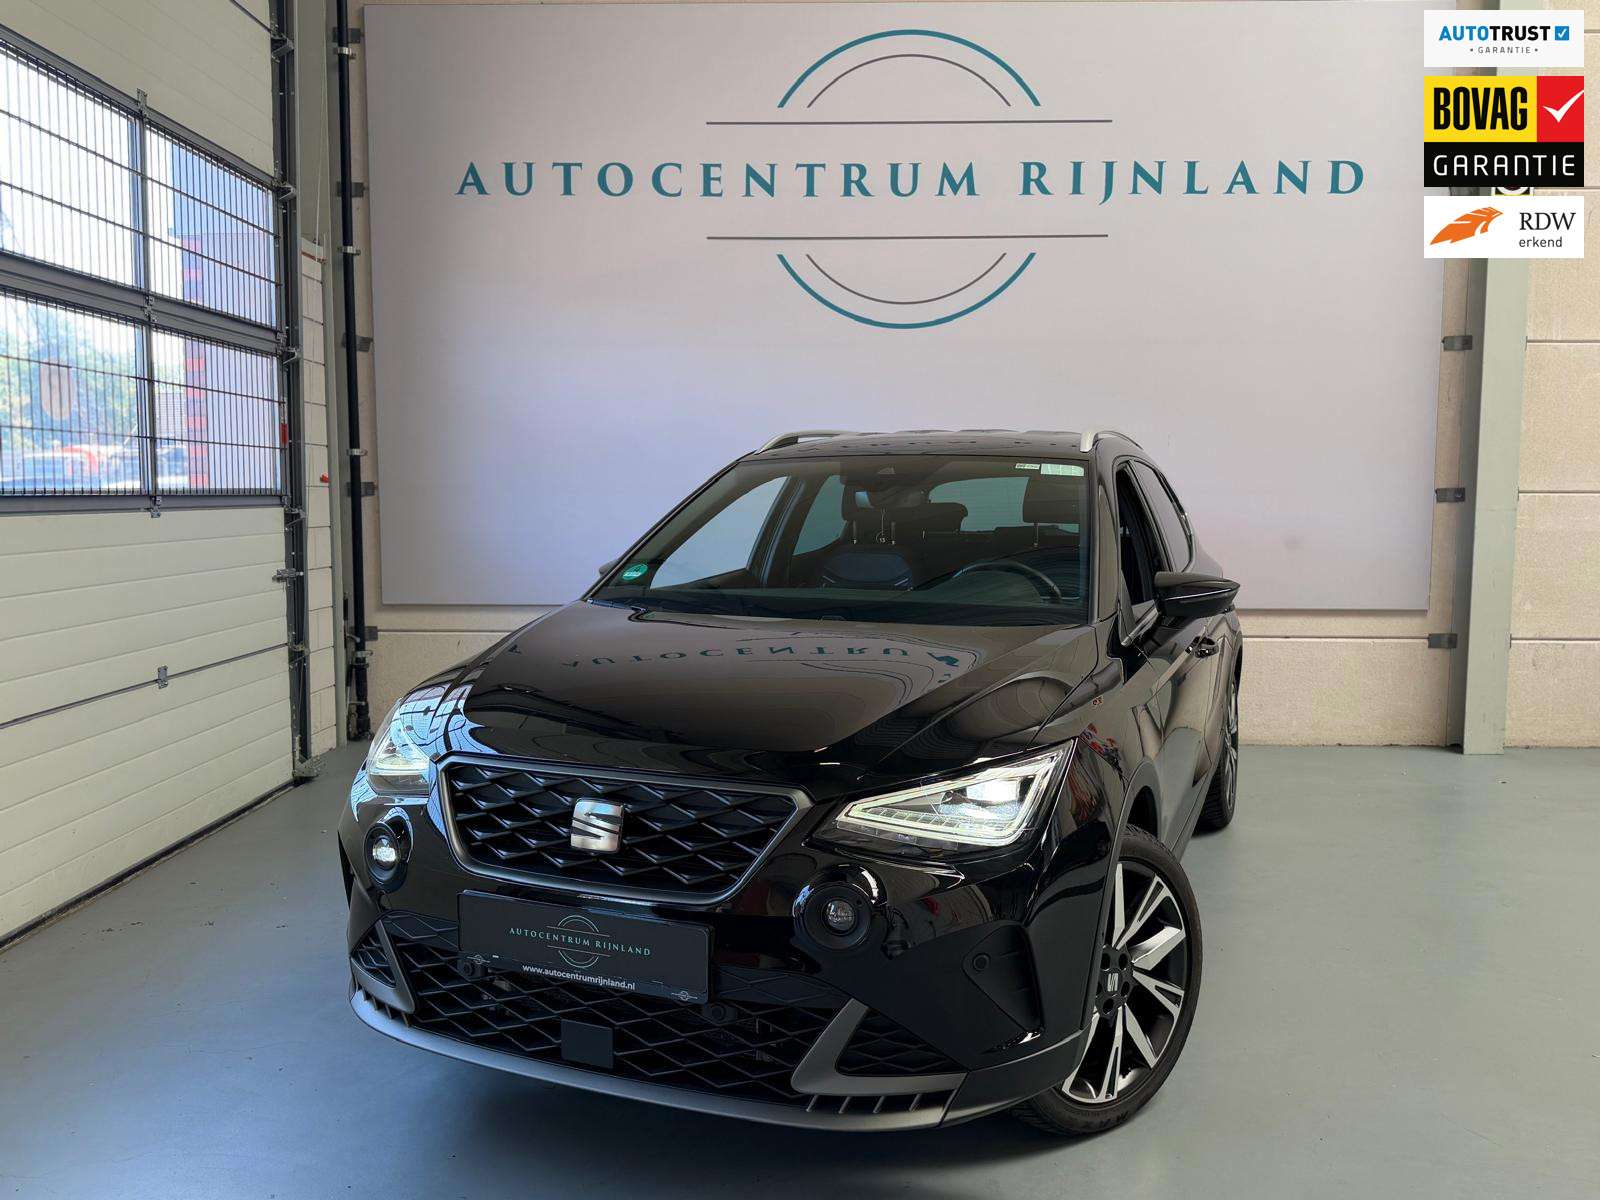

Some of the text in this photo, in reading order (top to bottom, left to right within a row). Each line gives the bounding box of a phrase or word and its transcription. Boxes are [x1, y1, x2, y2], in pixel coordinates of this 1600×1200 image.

[454, 160, 1365, 206] AUTOCENTRUM RIJNLAND
[509, 927, 652, 957] AUTOCENTRUM RIJNLAND
[522, 964, 636, 990] www.autocentrumrijnland.nl
